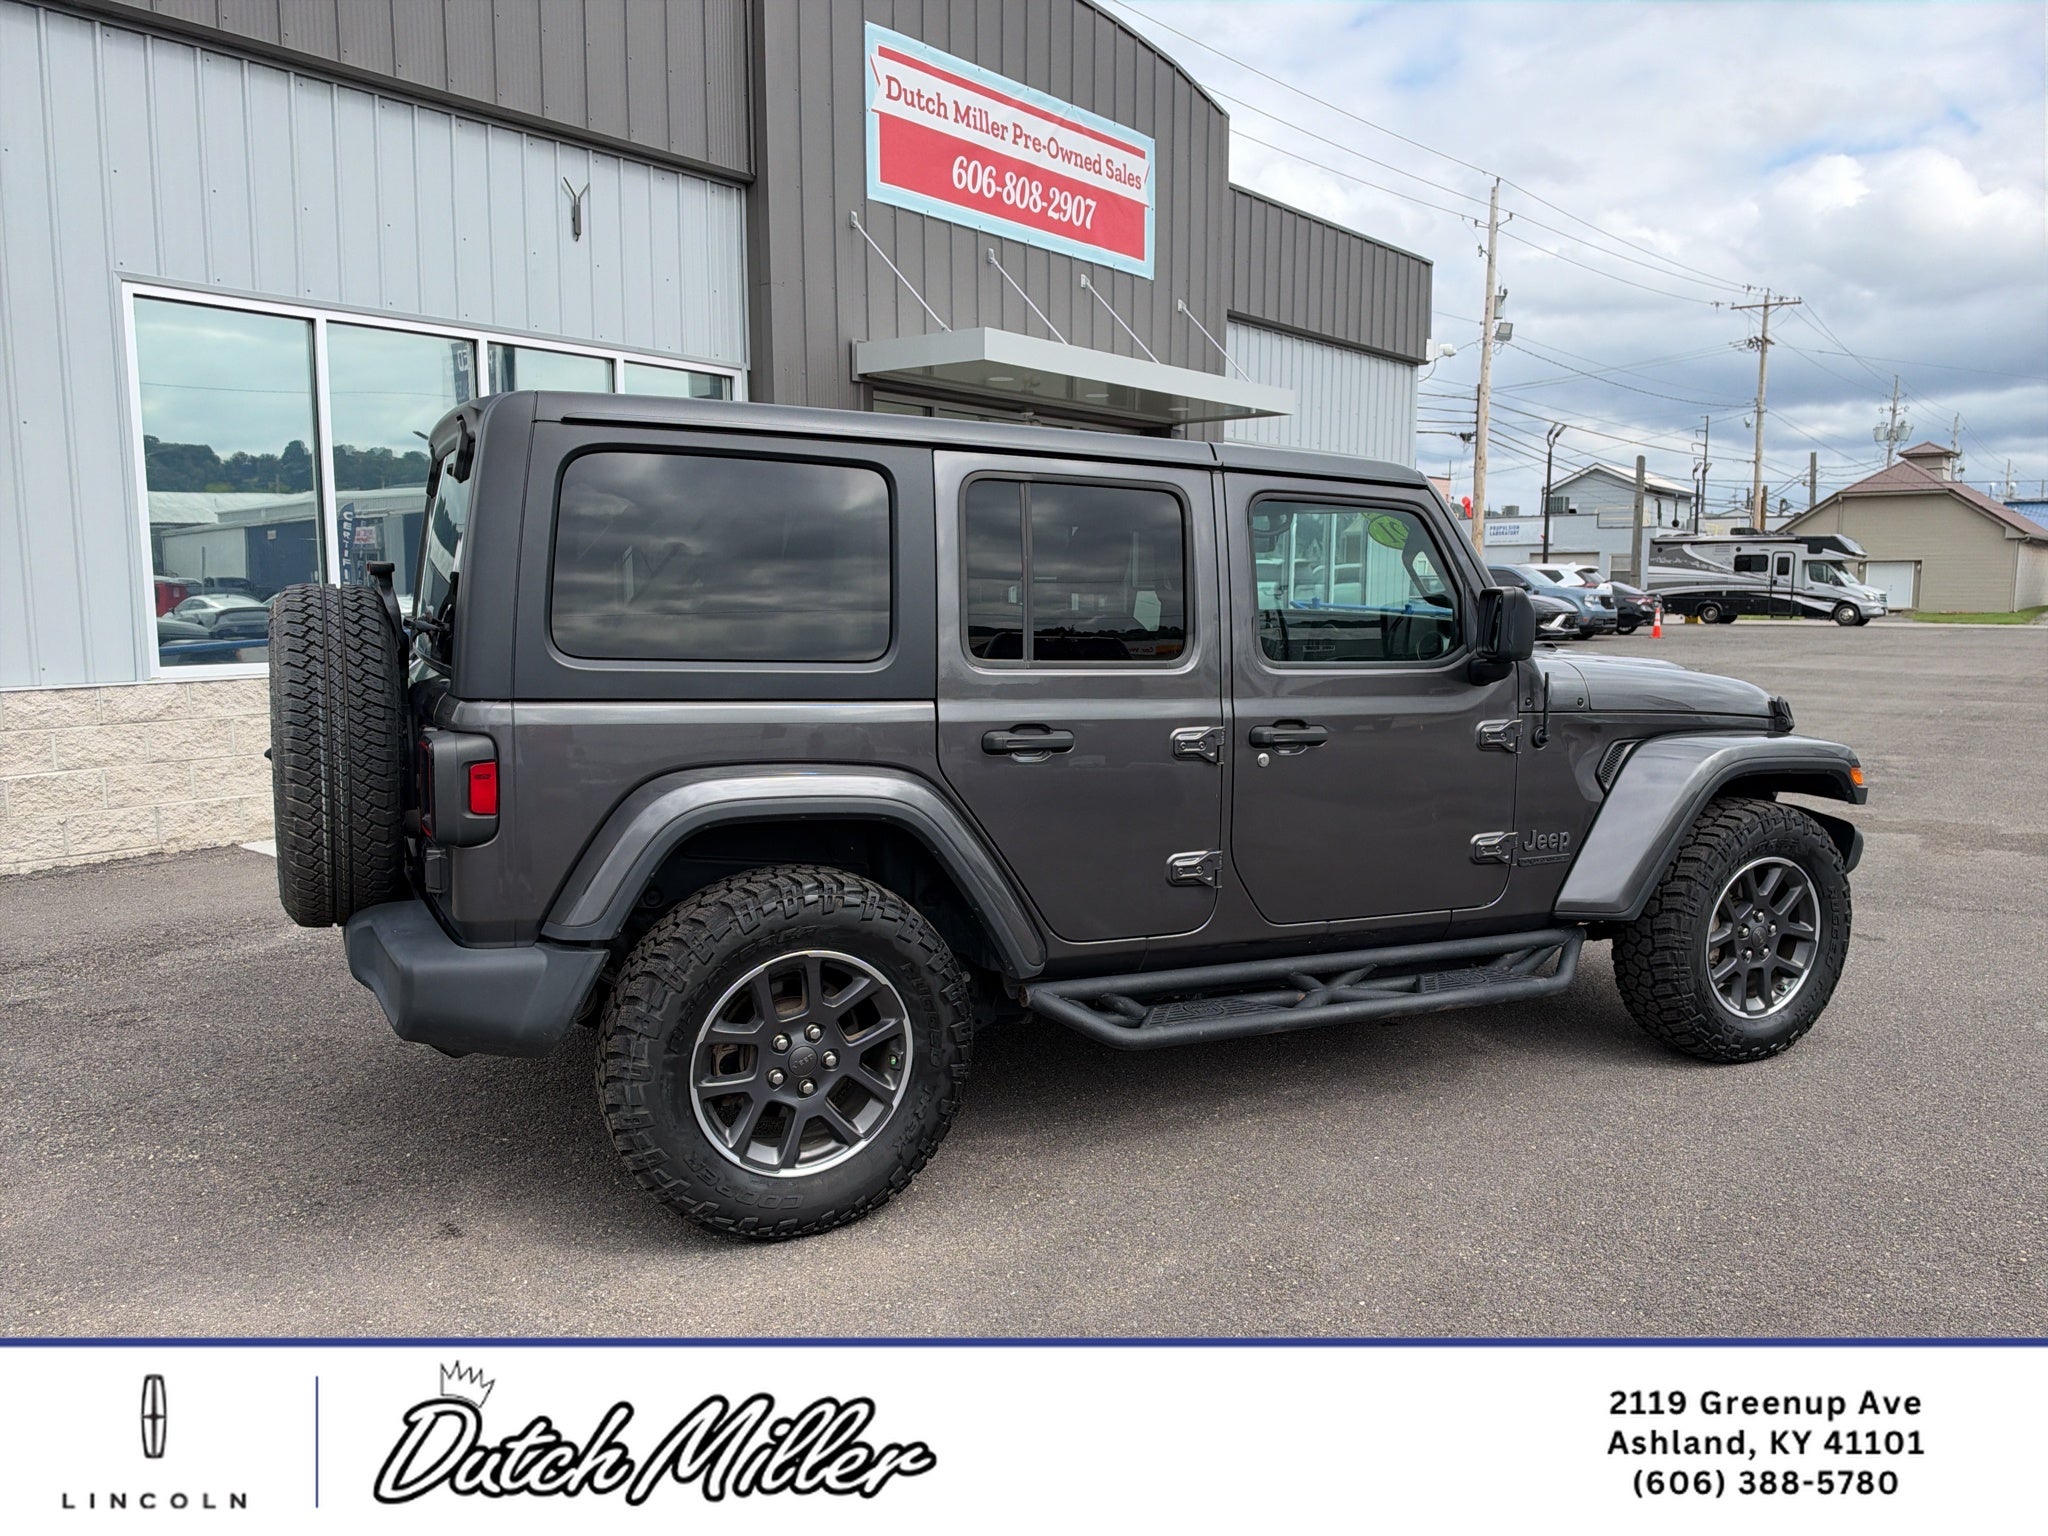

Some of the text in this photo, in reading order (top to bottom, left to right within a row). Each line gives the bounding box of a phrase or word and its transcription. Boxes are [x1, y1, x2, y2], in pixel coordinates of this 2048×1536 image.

[885, 74, 1142, 190] Dutch Miller Pre-Owned Sales
[952, 155, 1097, 231] 606-808-2907
[1522, 829, 1570, 852] Jeep
